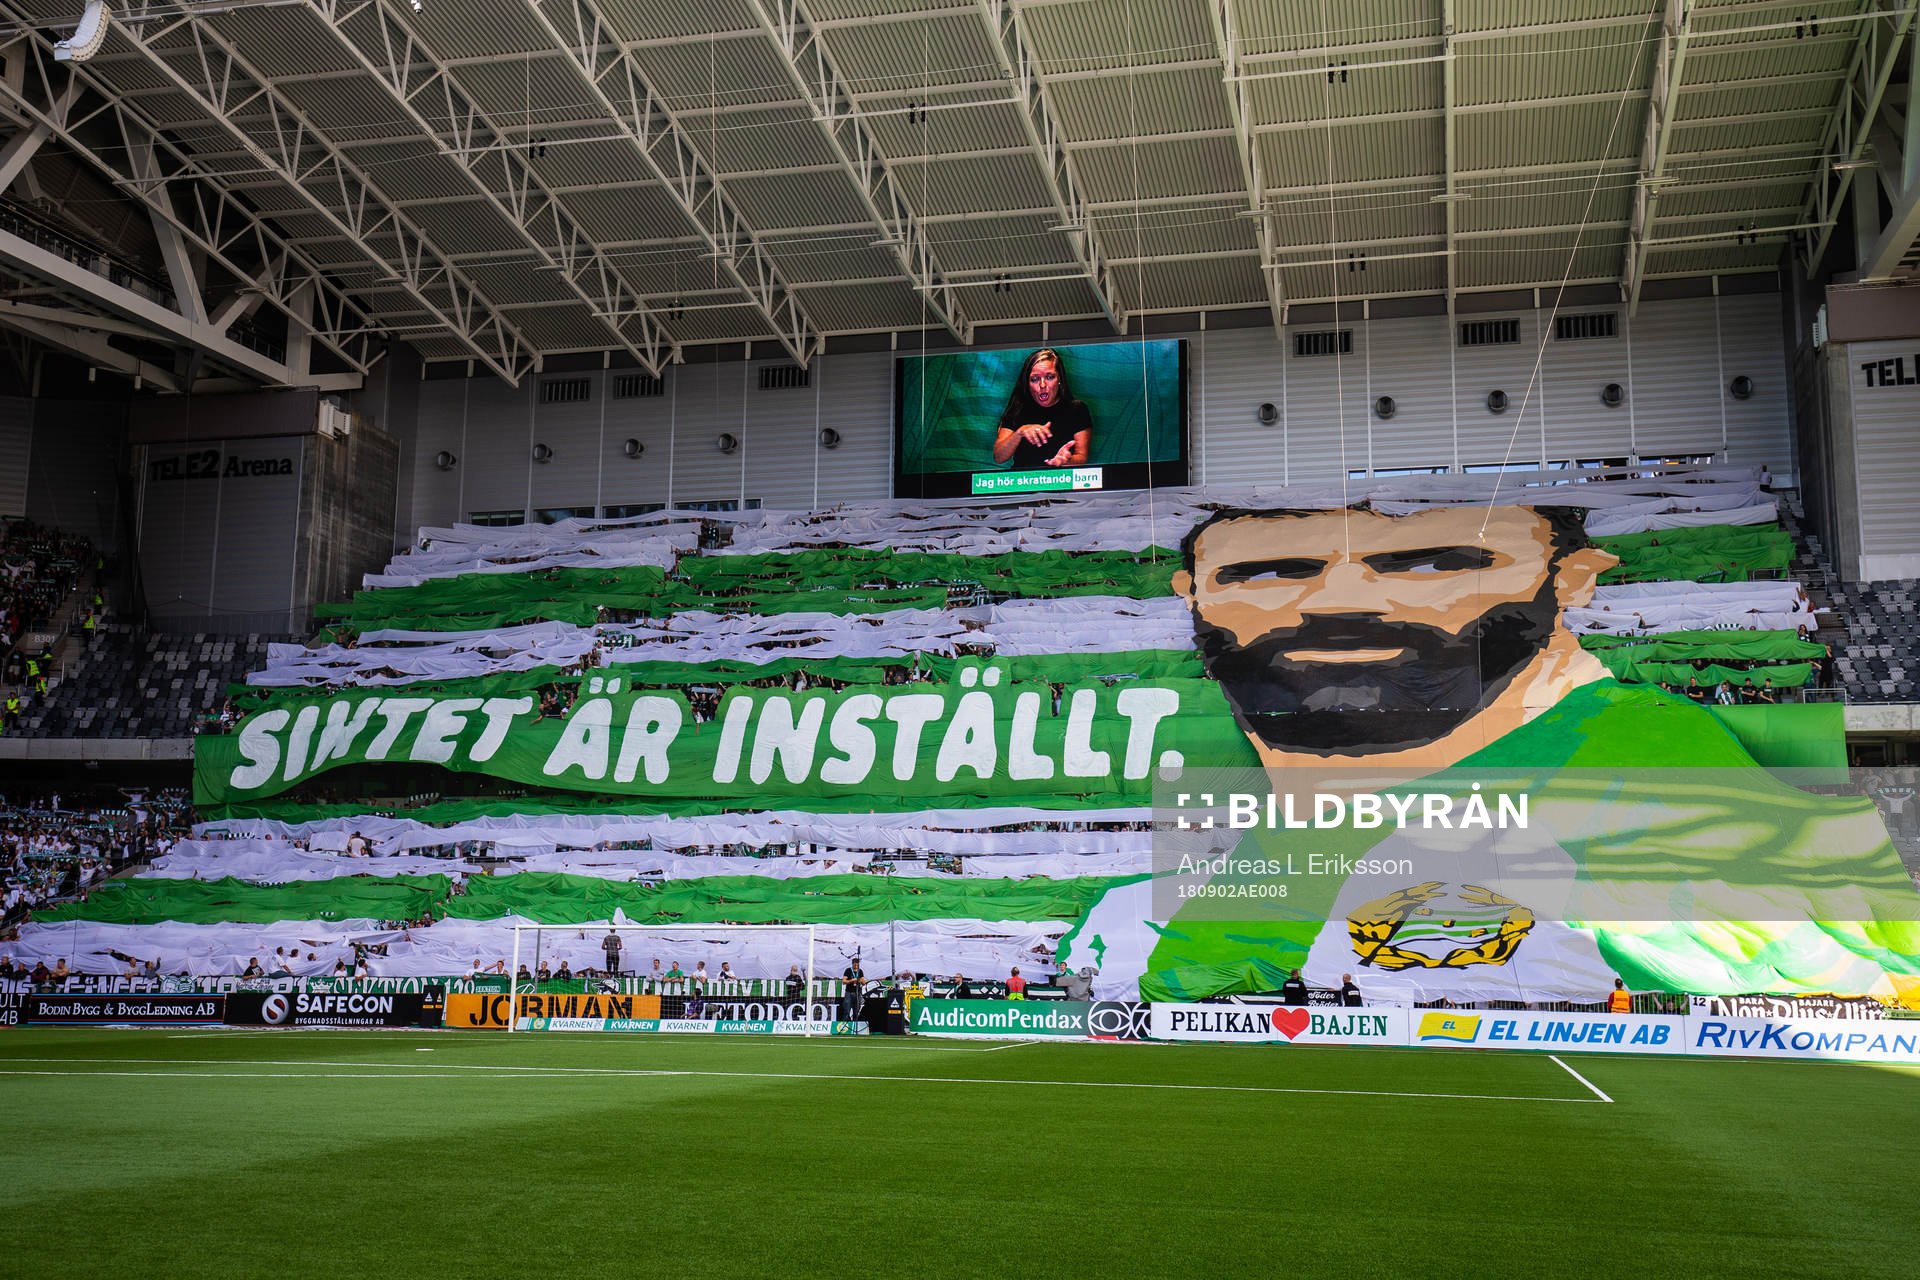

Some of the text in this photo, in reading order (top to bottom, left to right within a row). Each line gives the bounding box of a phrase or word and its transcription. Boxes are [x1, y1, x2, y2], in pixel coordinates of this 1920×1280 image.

[221, 456, 293, 477] Arena
[975, 473, 1098, 489] Jag hör skrattande barn
[543, 677, 683, 784] ÄR
[712, 666, 1185, 785] INSTÄLLT.
[296, 993, 393, 1014] SAFECON
[1692, 997, 1706, 1006] 12
[39, 1002, 215, 1016] BODIN BYGG & BYGGLEDNING AB
[295, 1017, 374, 1025] BYGGNADSSTÄLLNINGAR
[552, 1020, 592, 1029] KVARNEN
[917, 1006, 1083, 1029] AudicomPendax
[1170, 1010, 1389, 1037] PELIKAN BAJEN
[611, 1020, 654, 1030] KVARNEN
[666, 1021, 709, 1030] KVARNEN
[722, 1023, 767, 1031] KVARNEN
[785, 1024, 829, 1032] KVANEN
[1442, 1021, 1456, 1030] EL
[1488, 1020, 1671, 1045] EL LINJEN AB
[1696, 1021, 1920, 1054] RIVKOMPAN
